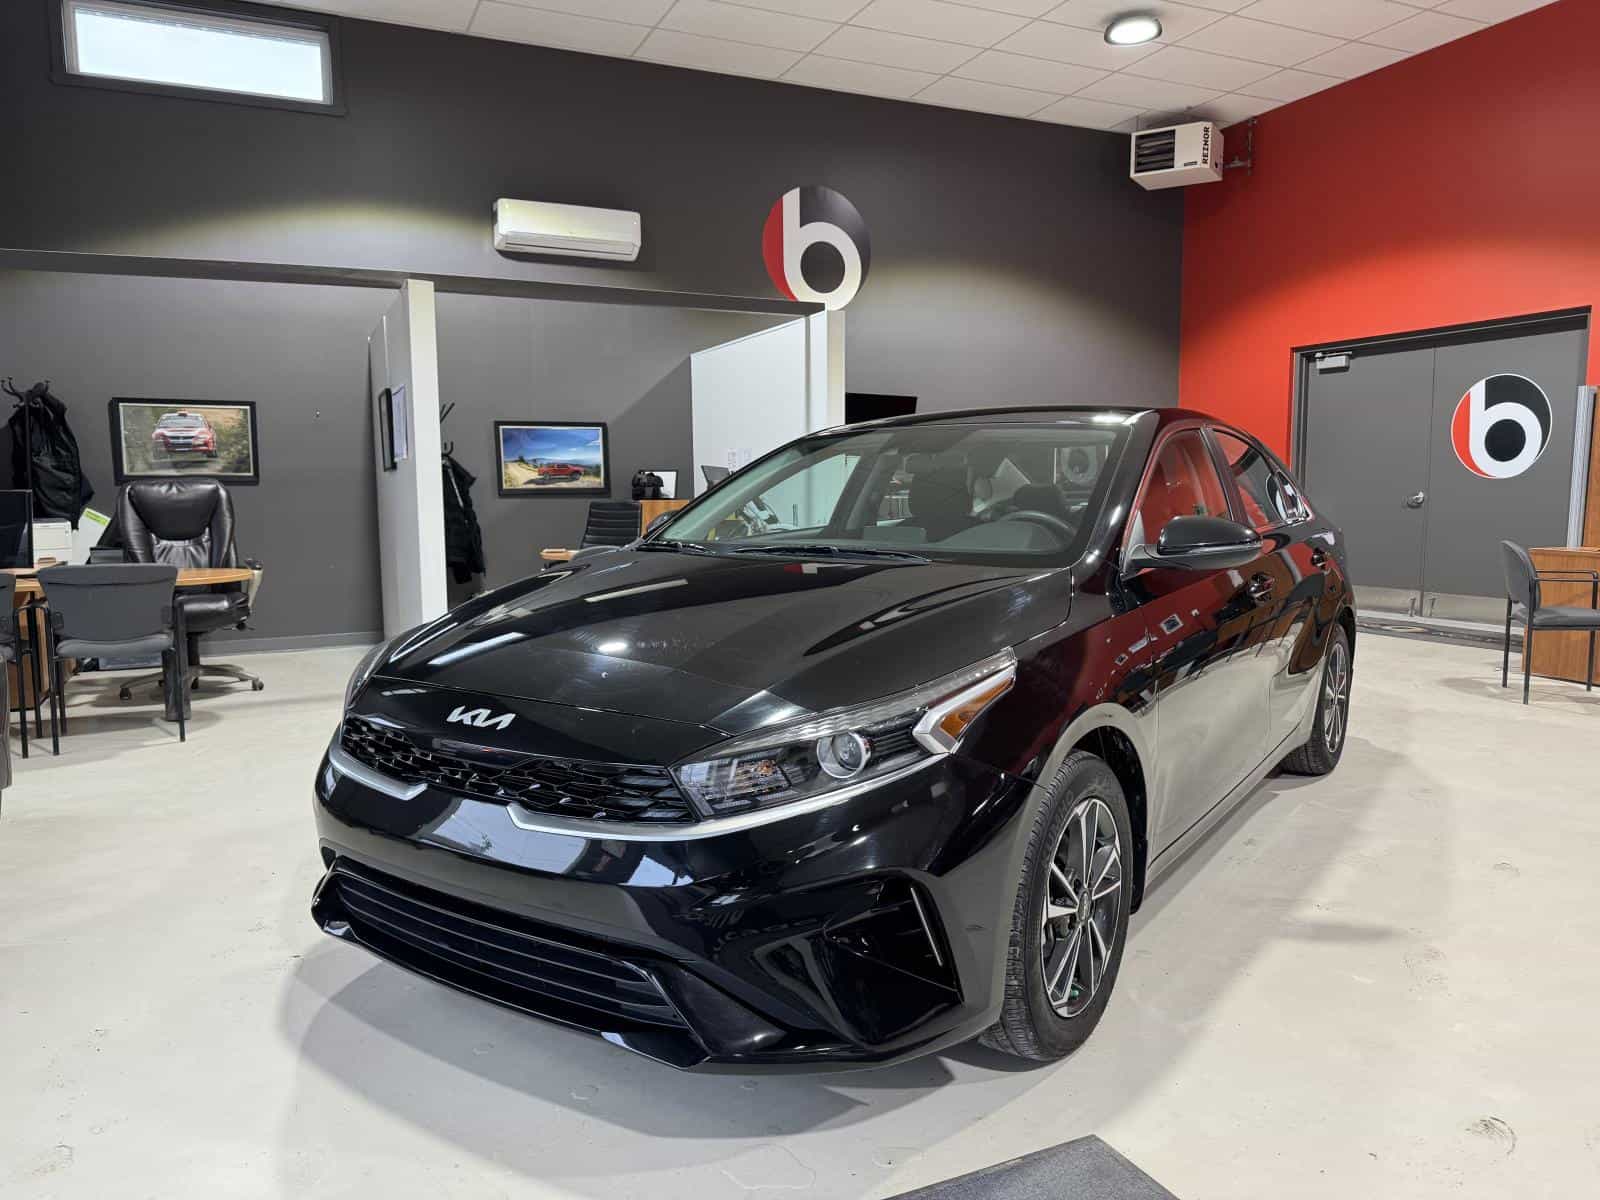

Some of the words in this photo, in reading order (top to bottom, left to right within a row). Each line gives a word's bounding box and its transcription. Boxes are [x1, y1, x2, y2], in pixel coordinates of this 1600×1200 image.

[1202, 126, 1210, 165] REZNOR
[1468, 378, 1543, 479] b
[446, 705, 517, 731] KIA
